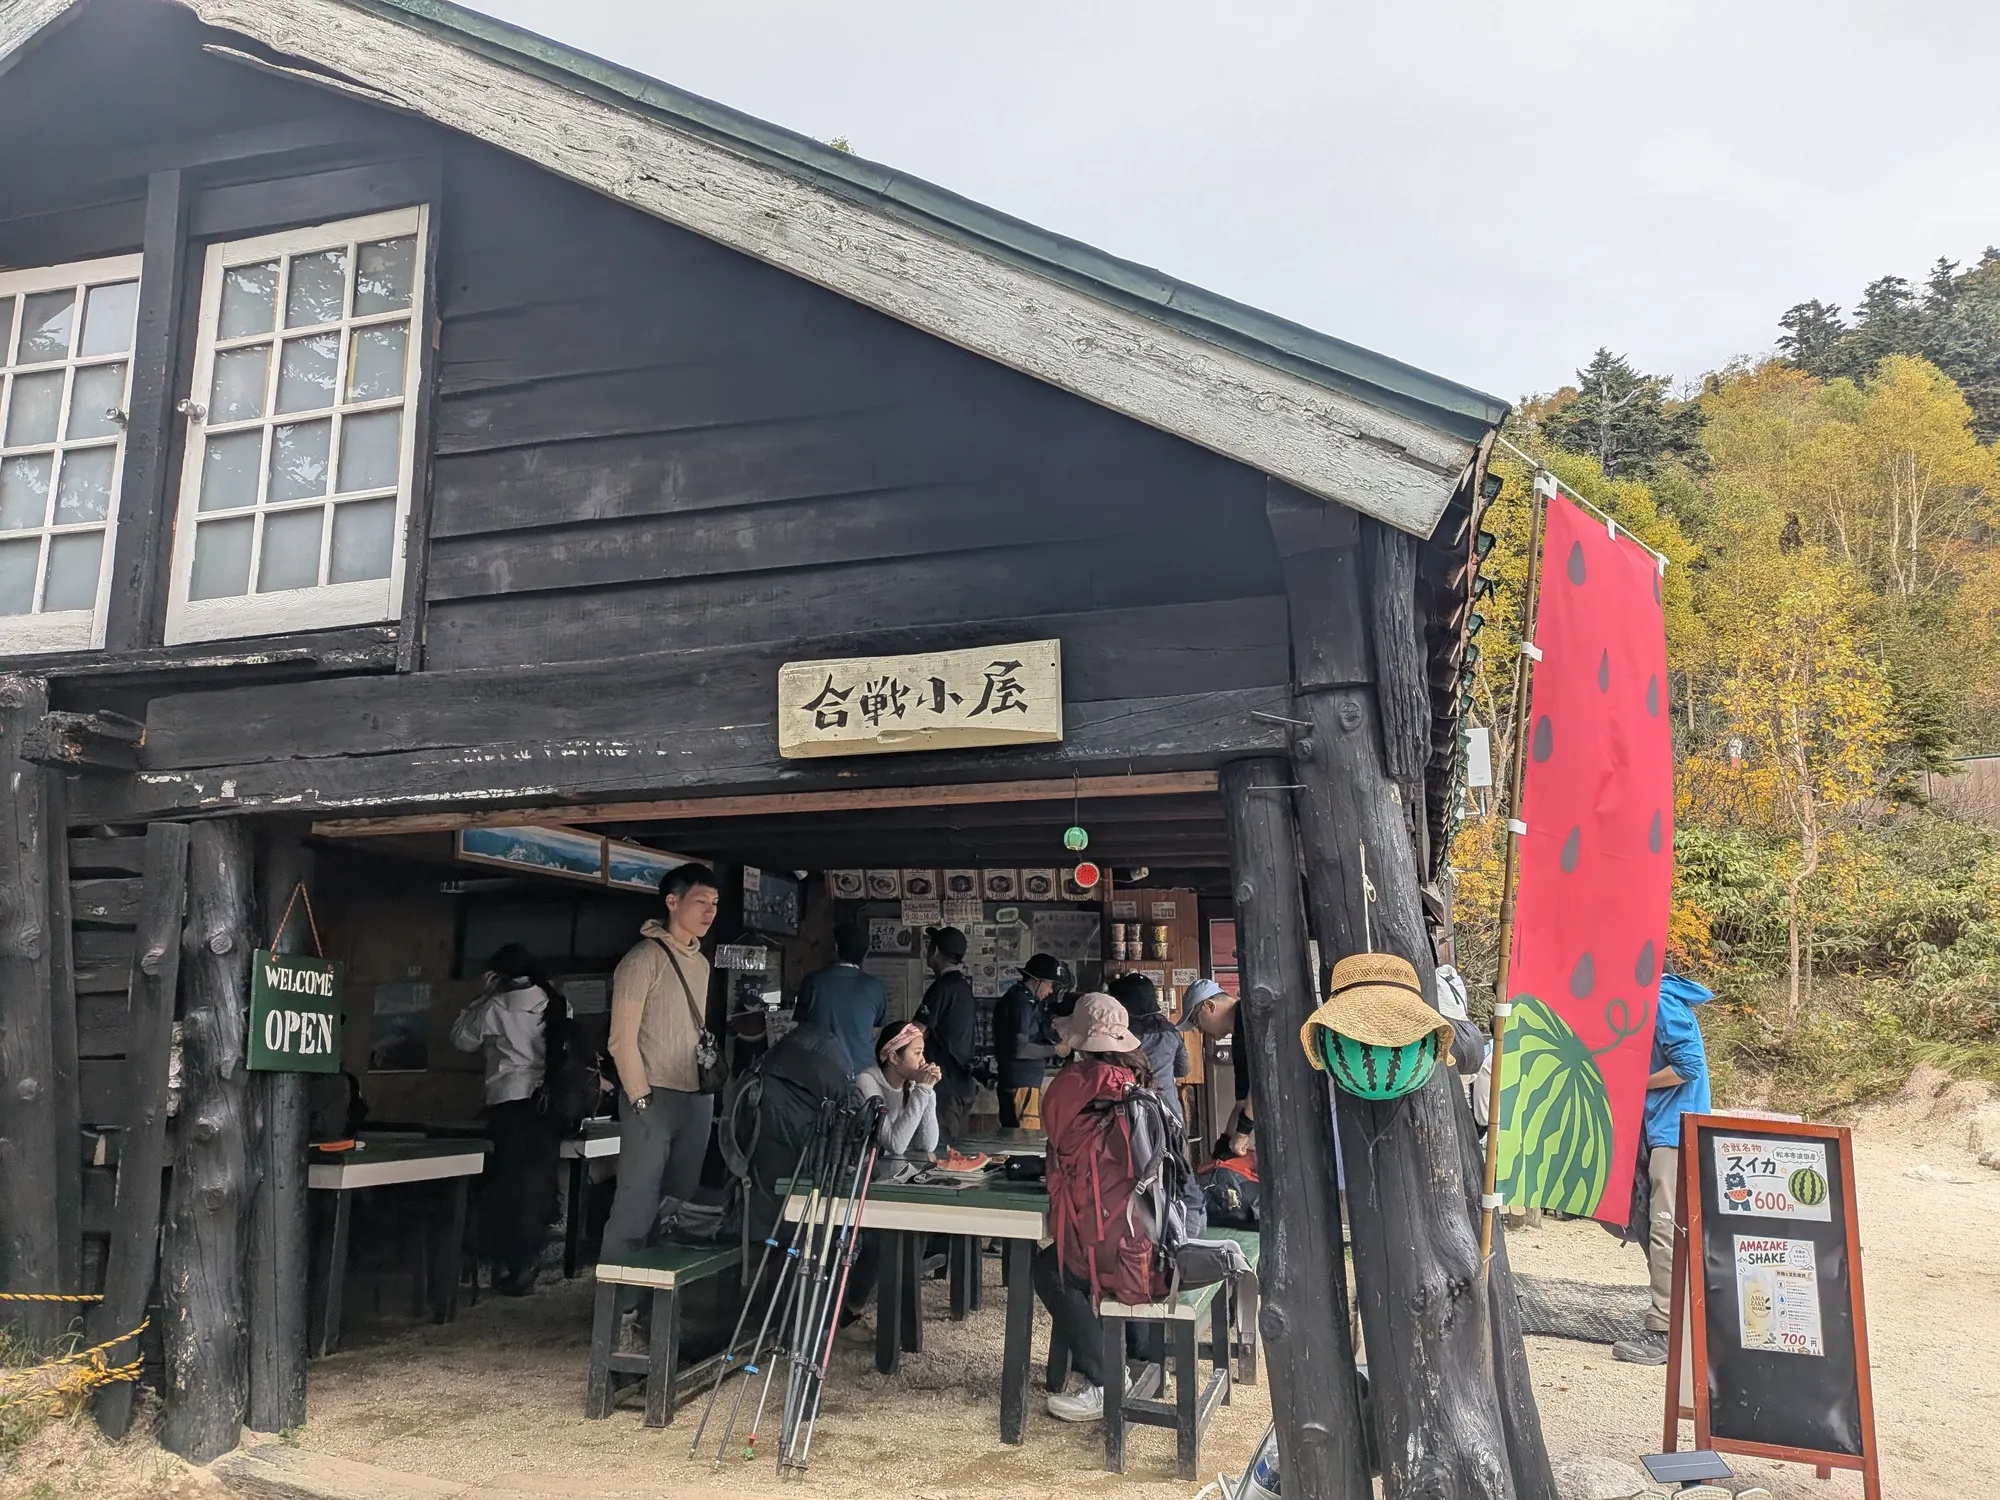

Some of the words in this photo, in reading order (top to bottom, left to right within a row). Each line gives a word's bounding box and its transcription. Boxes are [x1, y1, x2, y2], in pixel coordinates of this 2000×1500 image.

[801, 660, 1029, 731] 合戦小屋
[265, 965, 334, 997] WELCOME
[265, 1009, 334, 1055] OPEN
[1721, 1142, 1762, 1153] 合戦名物
[1727, 1156, 1777, 1175] スイカ
[1754, 1191, 1795, 1212] 600円
[1739, 1240, 1789, 1253] AMAZAKE
[1748, 1252, 1786, 1265] SHAKE
